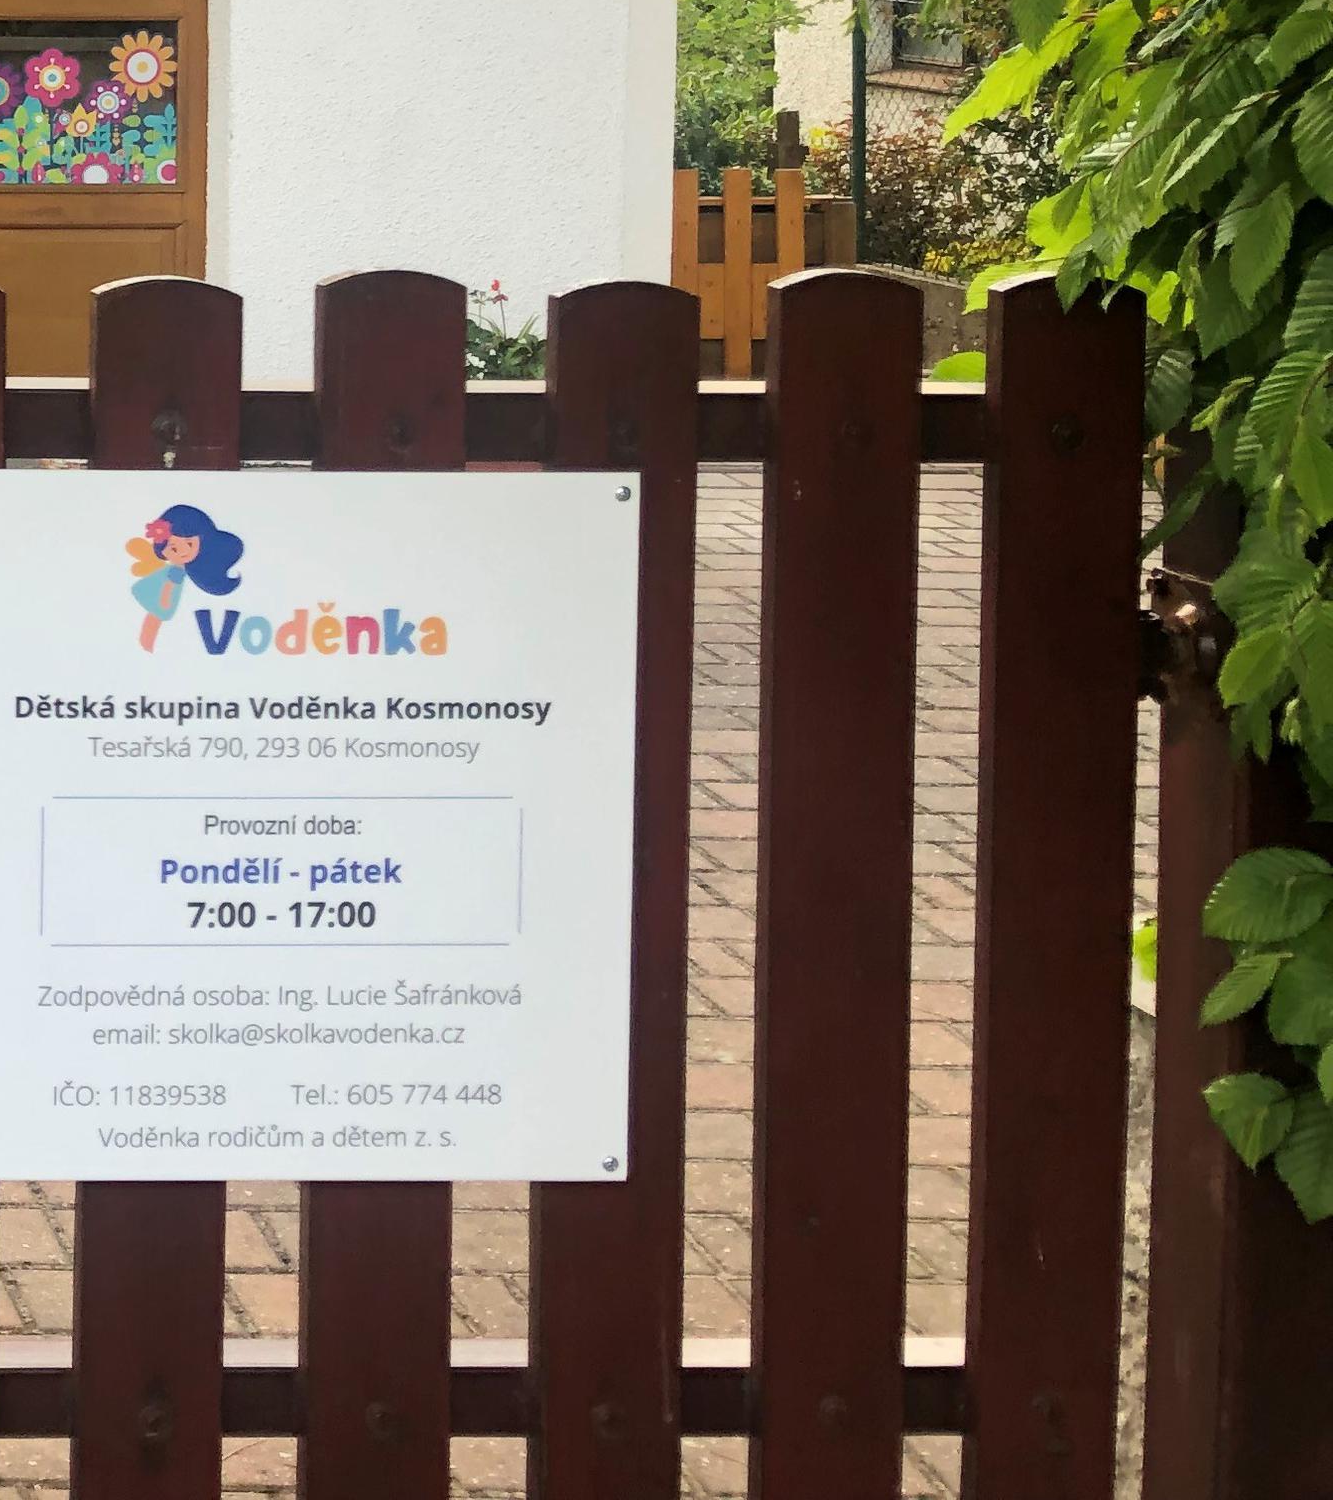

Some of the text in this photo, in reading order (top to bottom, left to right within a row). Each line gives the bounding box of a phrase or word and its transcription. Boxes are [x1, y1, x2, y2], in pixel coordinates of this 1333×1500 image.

[193, 601, 448, 656] Voděnka
[14, 694, 553, 727] Dětská skupina Voděnka Kosmonosy
[87, 735, 481, 765] Tesařská 790, 293 06 Kosmonosy
[204, 814, 362, 836] Provozní doba:
[160, 857, 284, 885] Pondělí
[309, 856, 403, 892] pátek
[186, 900, 257, 929] 7:00
[288, 900, 377, 929] 17:00
[37, 979, 522, 1013] Zodpovědná osoba: Ing. Lucie Šafránková
[92, 1022, 466, 1047] email: skolka@skolkavodenka.cz
[53, 1080, 227, 1107] IČO: 11839538
[290, 1083, 502, 1106] Tel.: 605 774 448
[98, 1123, 457, 1149] Voděnka rodičům a dětem z. s.
